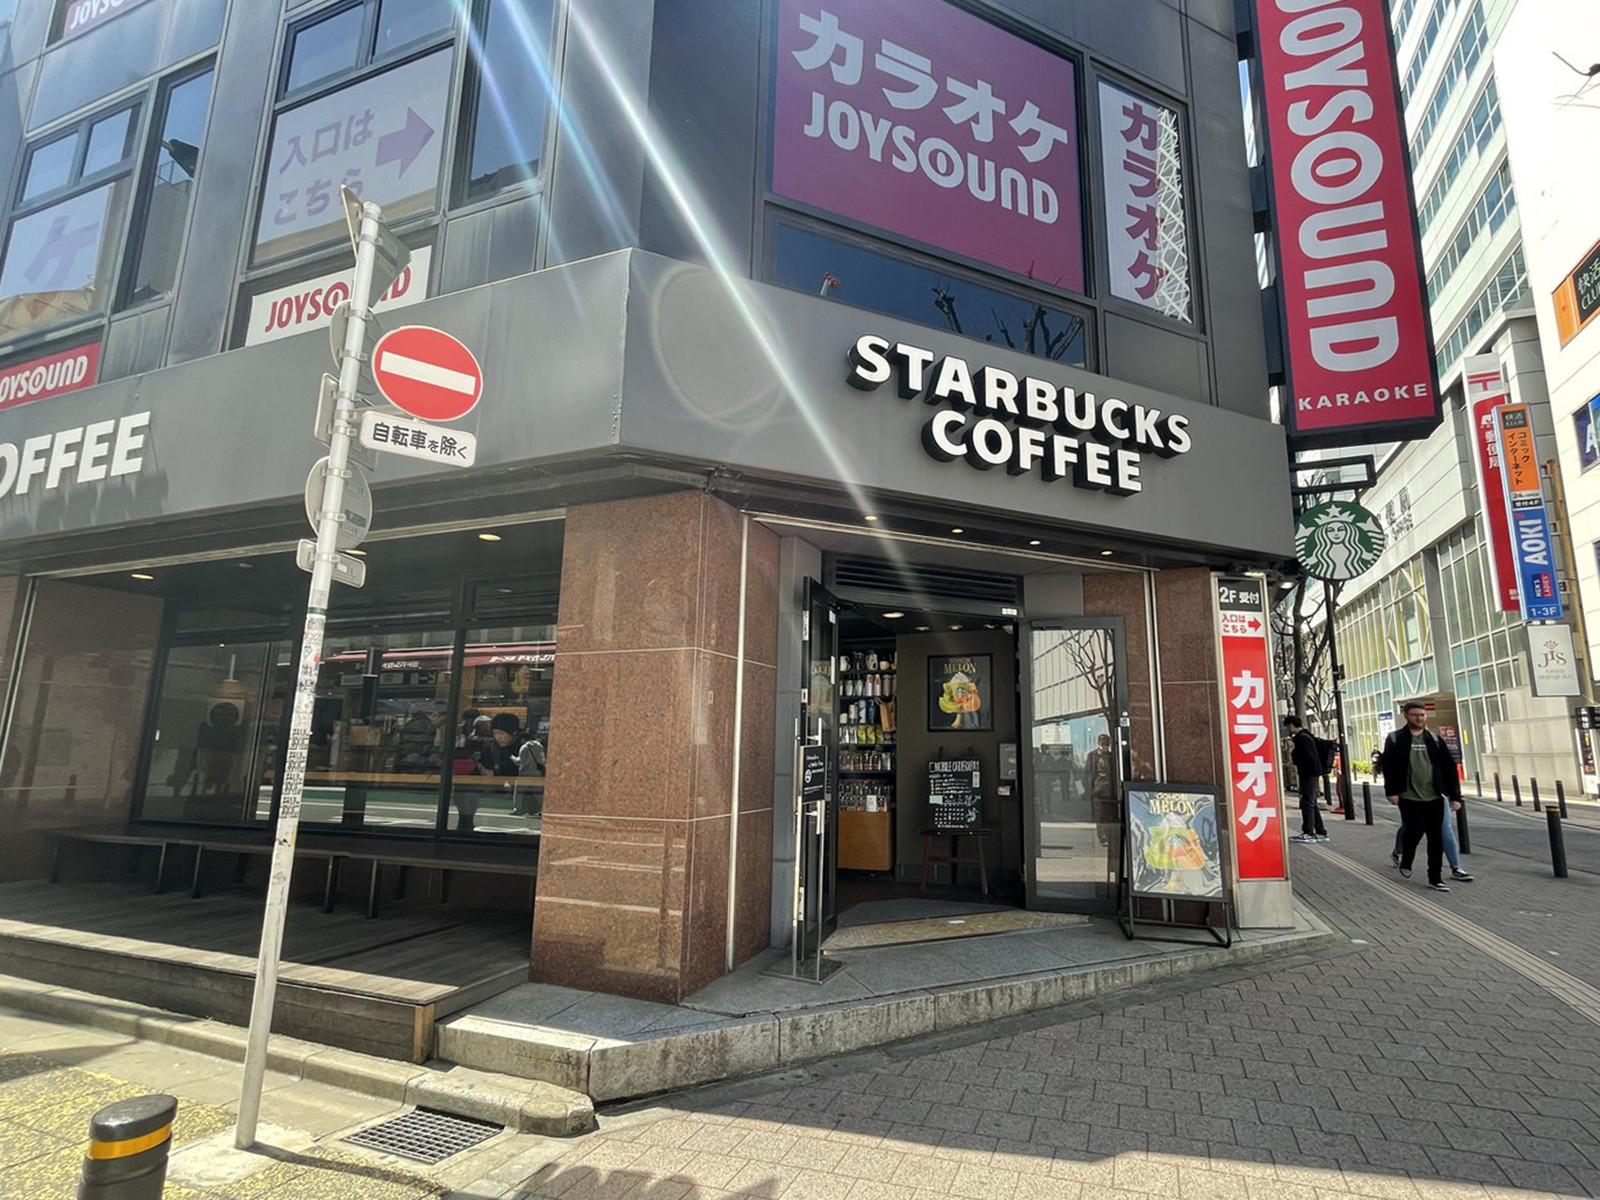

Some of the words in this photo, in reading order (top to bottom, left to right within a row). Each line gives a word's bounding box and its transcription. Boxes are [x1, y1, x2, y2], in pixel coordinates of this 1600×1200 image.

[791, 9, 1069, 164] カラオケ
[279, 108, 375, 175] 入口は
[803, 92, 1060, 225] JOYSOUND
[274, 168, 364, 226] こちら
[1119, 102, 1170, 300] カラオケ
[264, 266, 411, 333] JOYSOD
[1581, 281, 1600, 310] CLU
[854, 333, 1193, 455] STARBUCKS
[1298, 383, 1429, 411] KARAOKE
[372, 422, 468, 460] 自転車を除く
[933, 409, 1143, 493] COFFEE
[1507, 433, 1523, 486] インターネット
[1517, 431, 1530, 463] コミック
[1518, 518, 1549, 565] AOKI
[1219, 586, 1237, 603] 2F
[1239, 591, 1260, 604] 受付
[1222, 613, 1246, 624] 入口は
[1531, 606, 1558, 617] 1-3F
[1223, 624, 1247, 634] こちら
[1231, 670, 1276, 842] カラオケ
[1149, 799, 1196, 816] MELON
